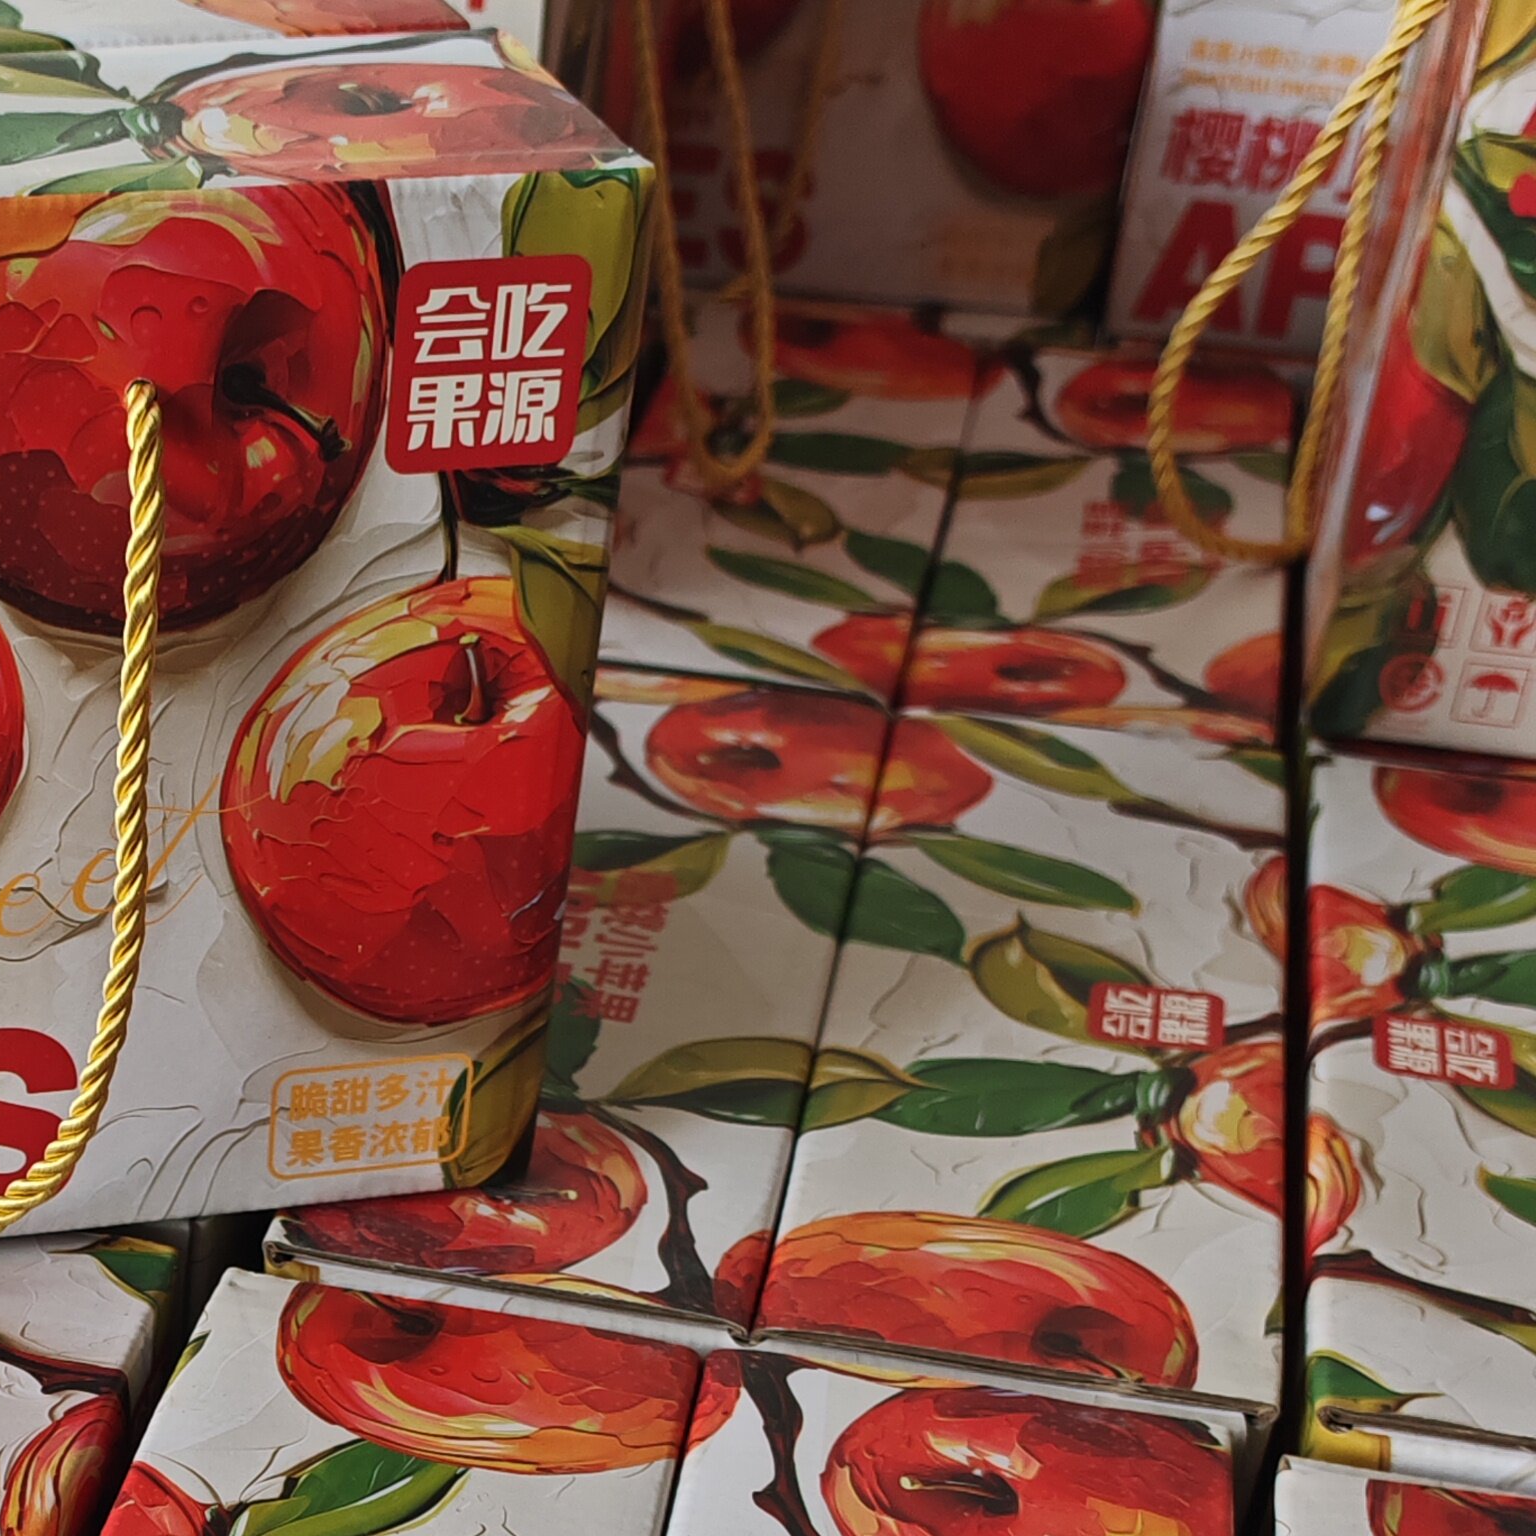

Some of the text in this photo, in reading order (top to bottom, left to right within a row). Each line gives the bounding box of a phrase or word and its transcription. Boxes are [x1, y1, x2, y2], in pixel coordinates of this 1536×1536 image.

[289, 1068, 455, 1121] 脆甜多汁
[286, 1115, 452, 1168] 果香浓郁
